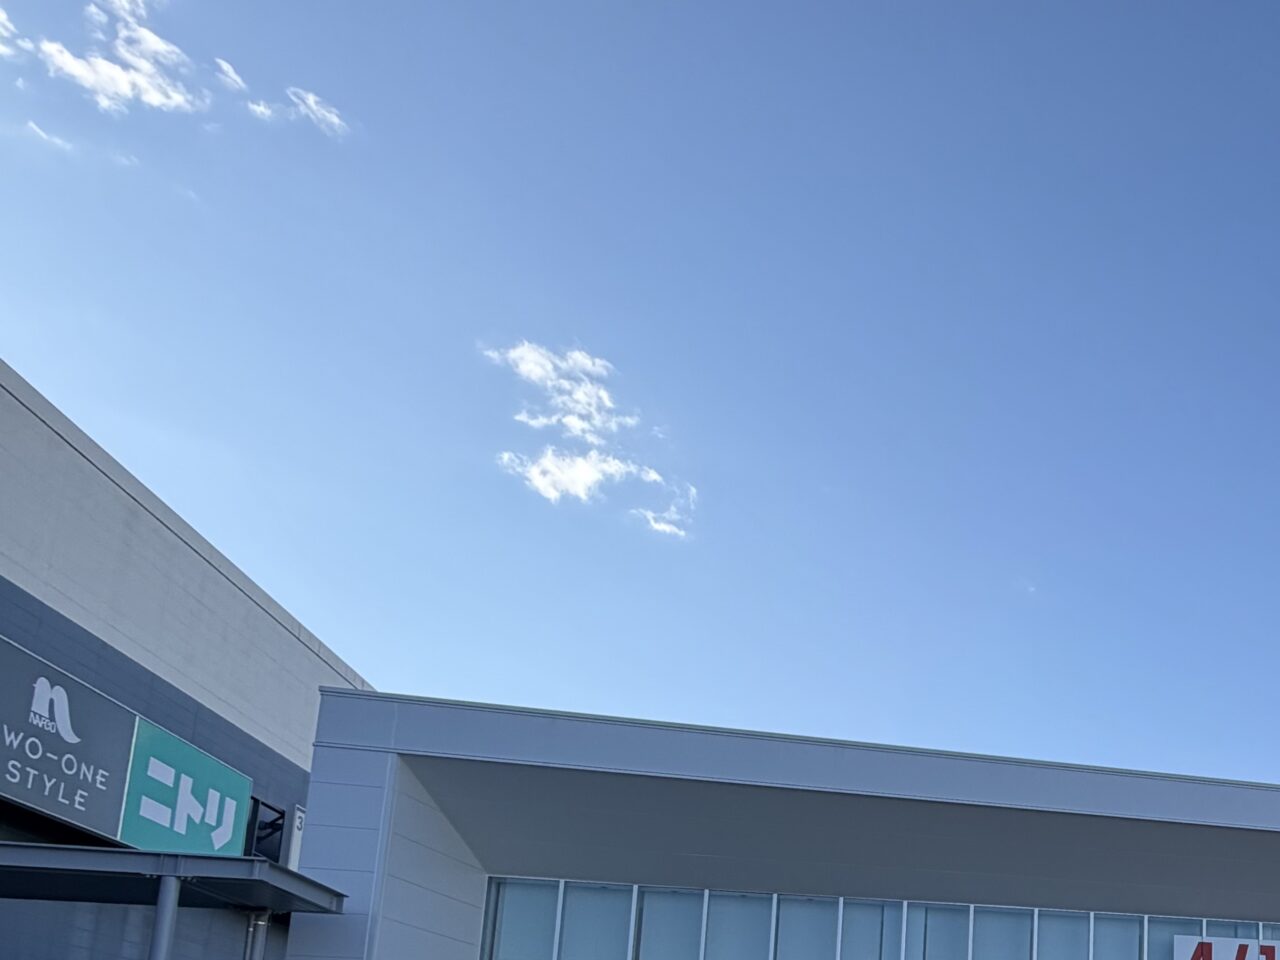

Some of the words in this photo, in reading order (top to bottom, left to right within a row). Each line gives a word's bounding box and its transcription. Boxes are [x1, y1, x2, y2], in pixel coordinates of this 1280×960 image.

[28, 711, 57, 733] NAFCO
[5, 760, 89, 811] STYLE
[139, 756, 237, 851] ニトリ
